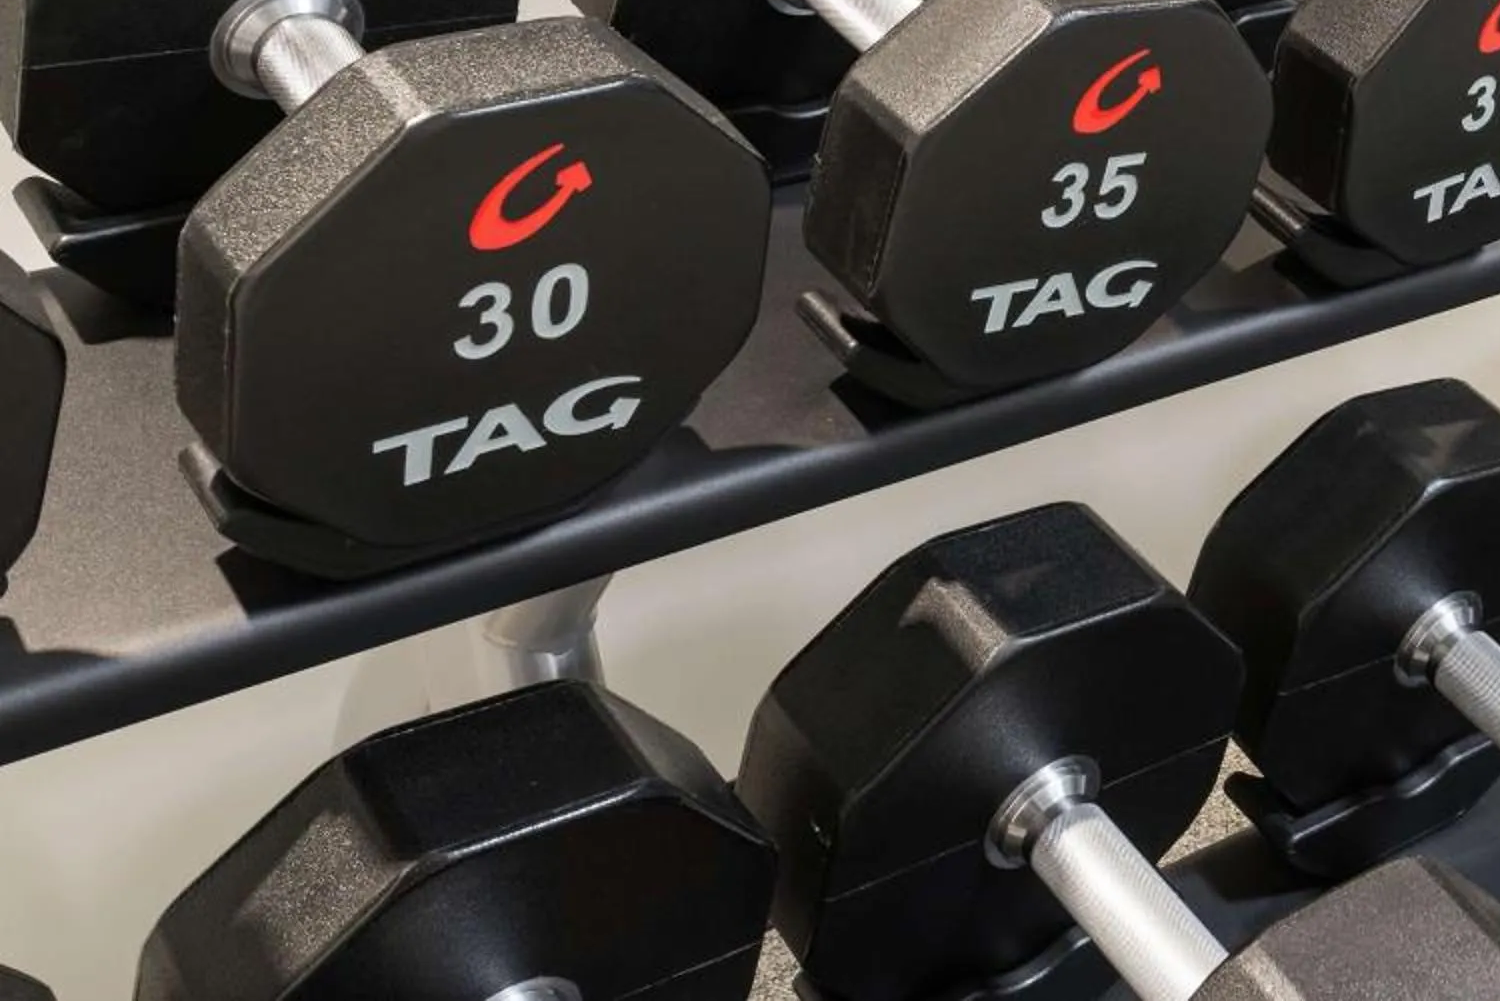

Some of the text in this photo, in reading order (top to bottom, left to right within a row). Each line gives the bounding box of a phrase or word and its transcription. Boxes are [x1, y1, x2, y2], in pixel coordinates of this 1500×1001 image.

[1041, 152, 1147, 229] 35
[453, 263, 589, 360] 30
[970, 260, 1158, 334] TAG
[372, 375, 642, 487] TAG
